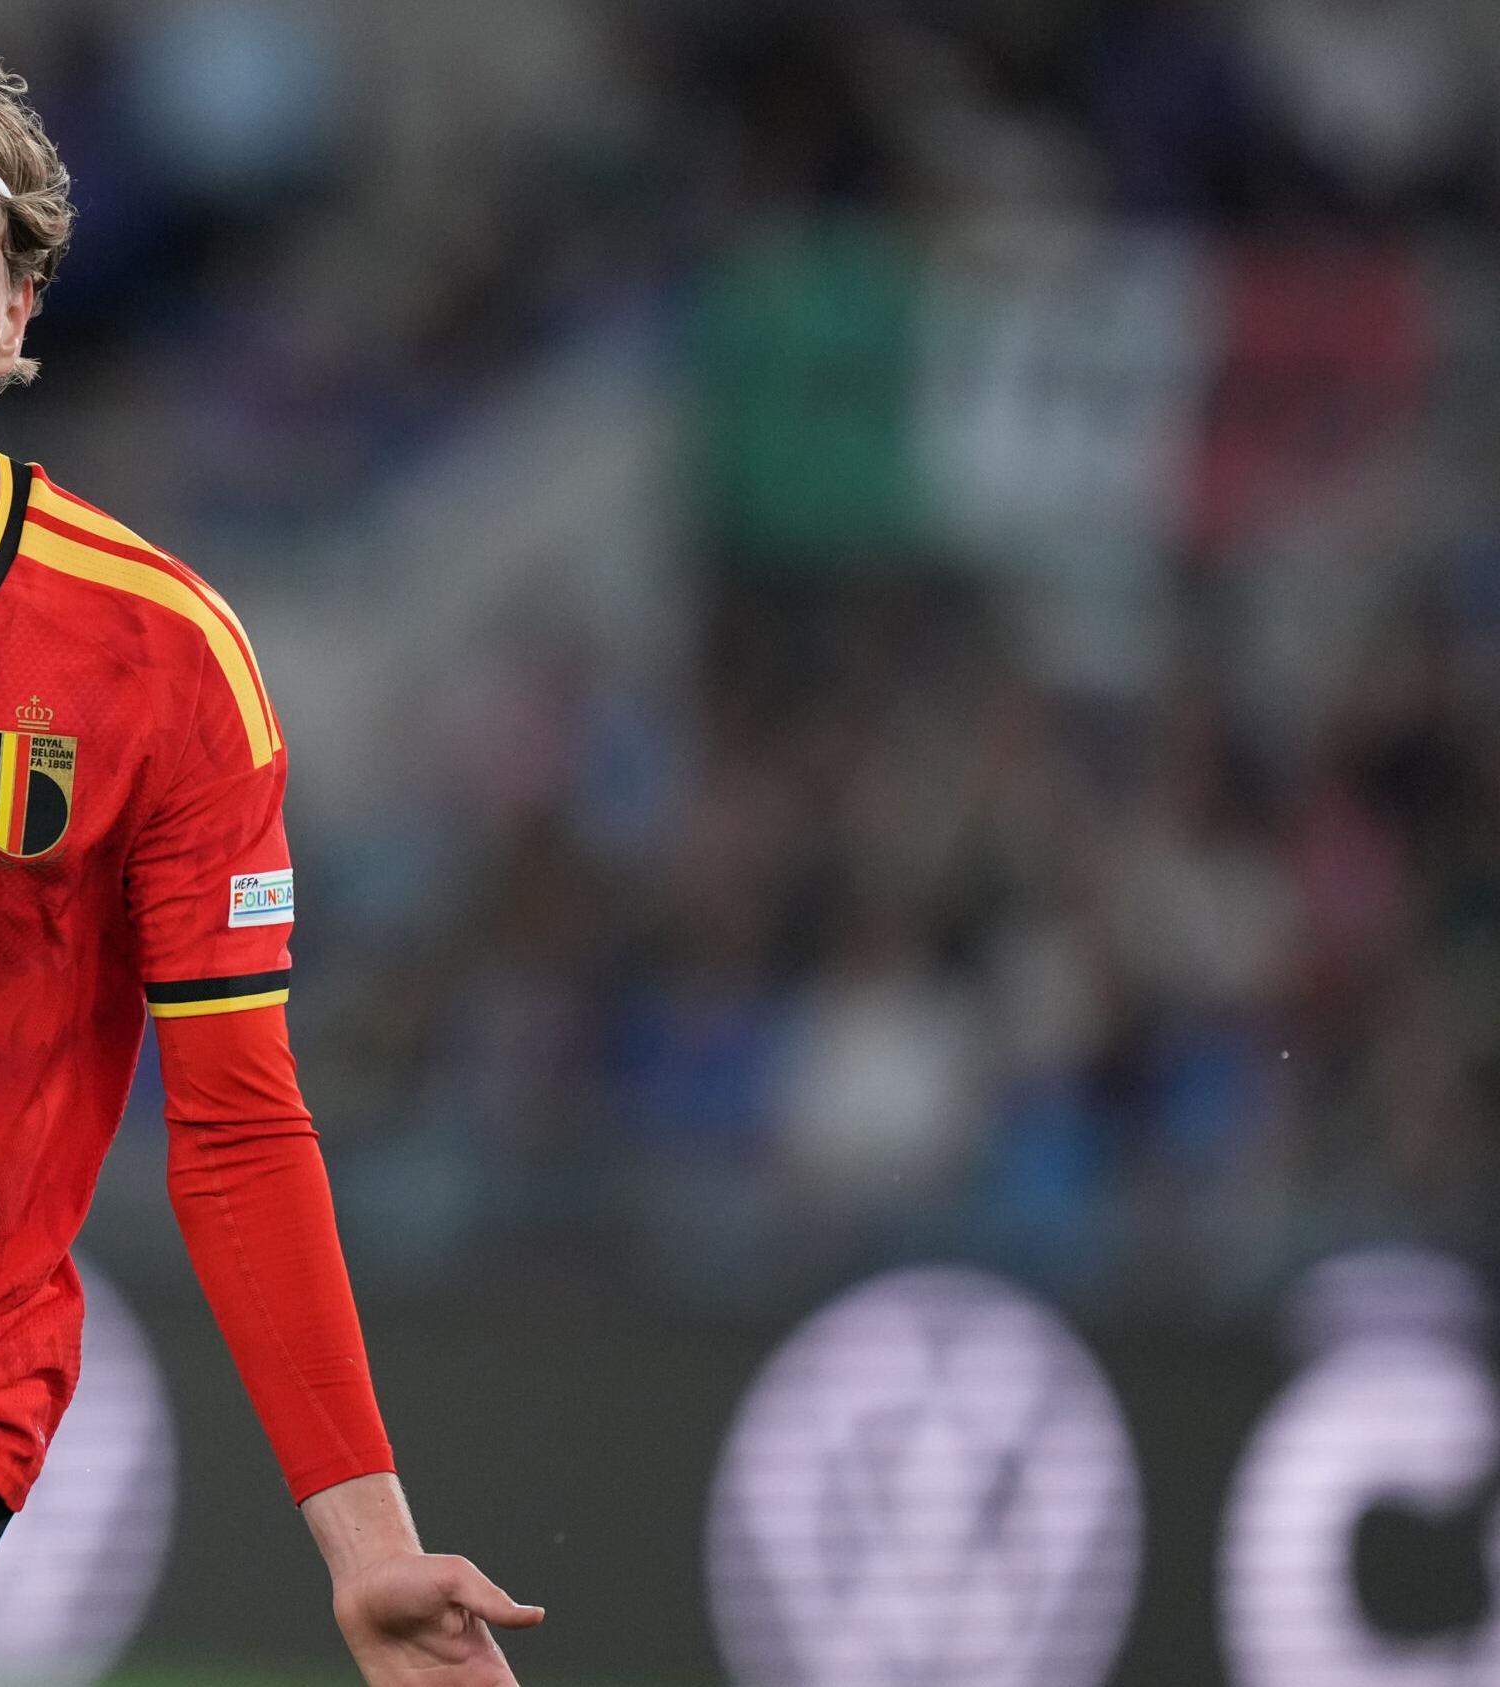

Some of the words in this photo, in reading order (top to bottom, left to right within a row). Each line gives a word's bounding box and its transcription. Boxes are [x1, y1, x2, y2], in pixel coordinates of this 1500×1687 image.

[32, 737, 63, 748] ROYAL
[31, 748, 73, 759] BELGIAN
[234, 877, 259, 890] UEFA
